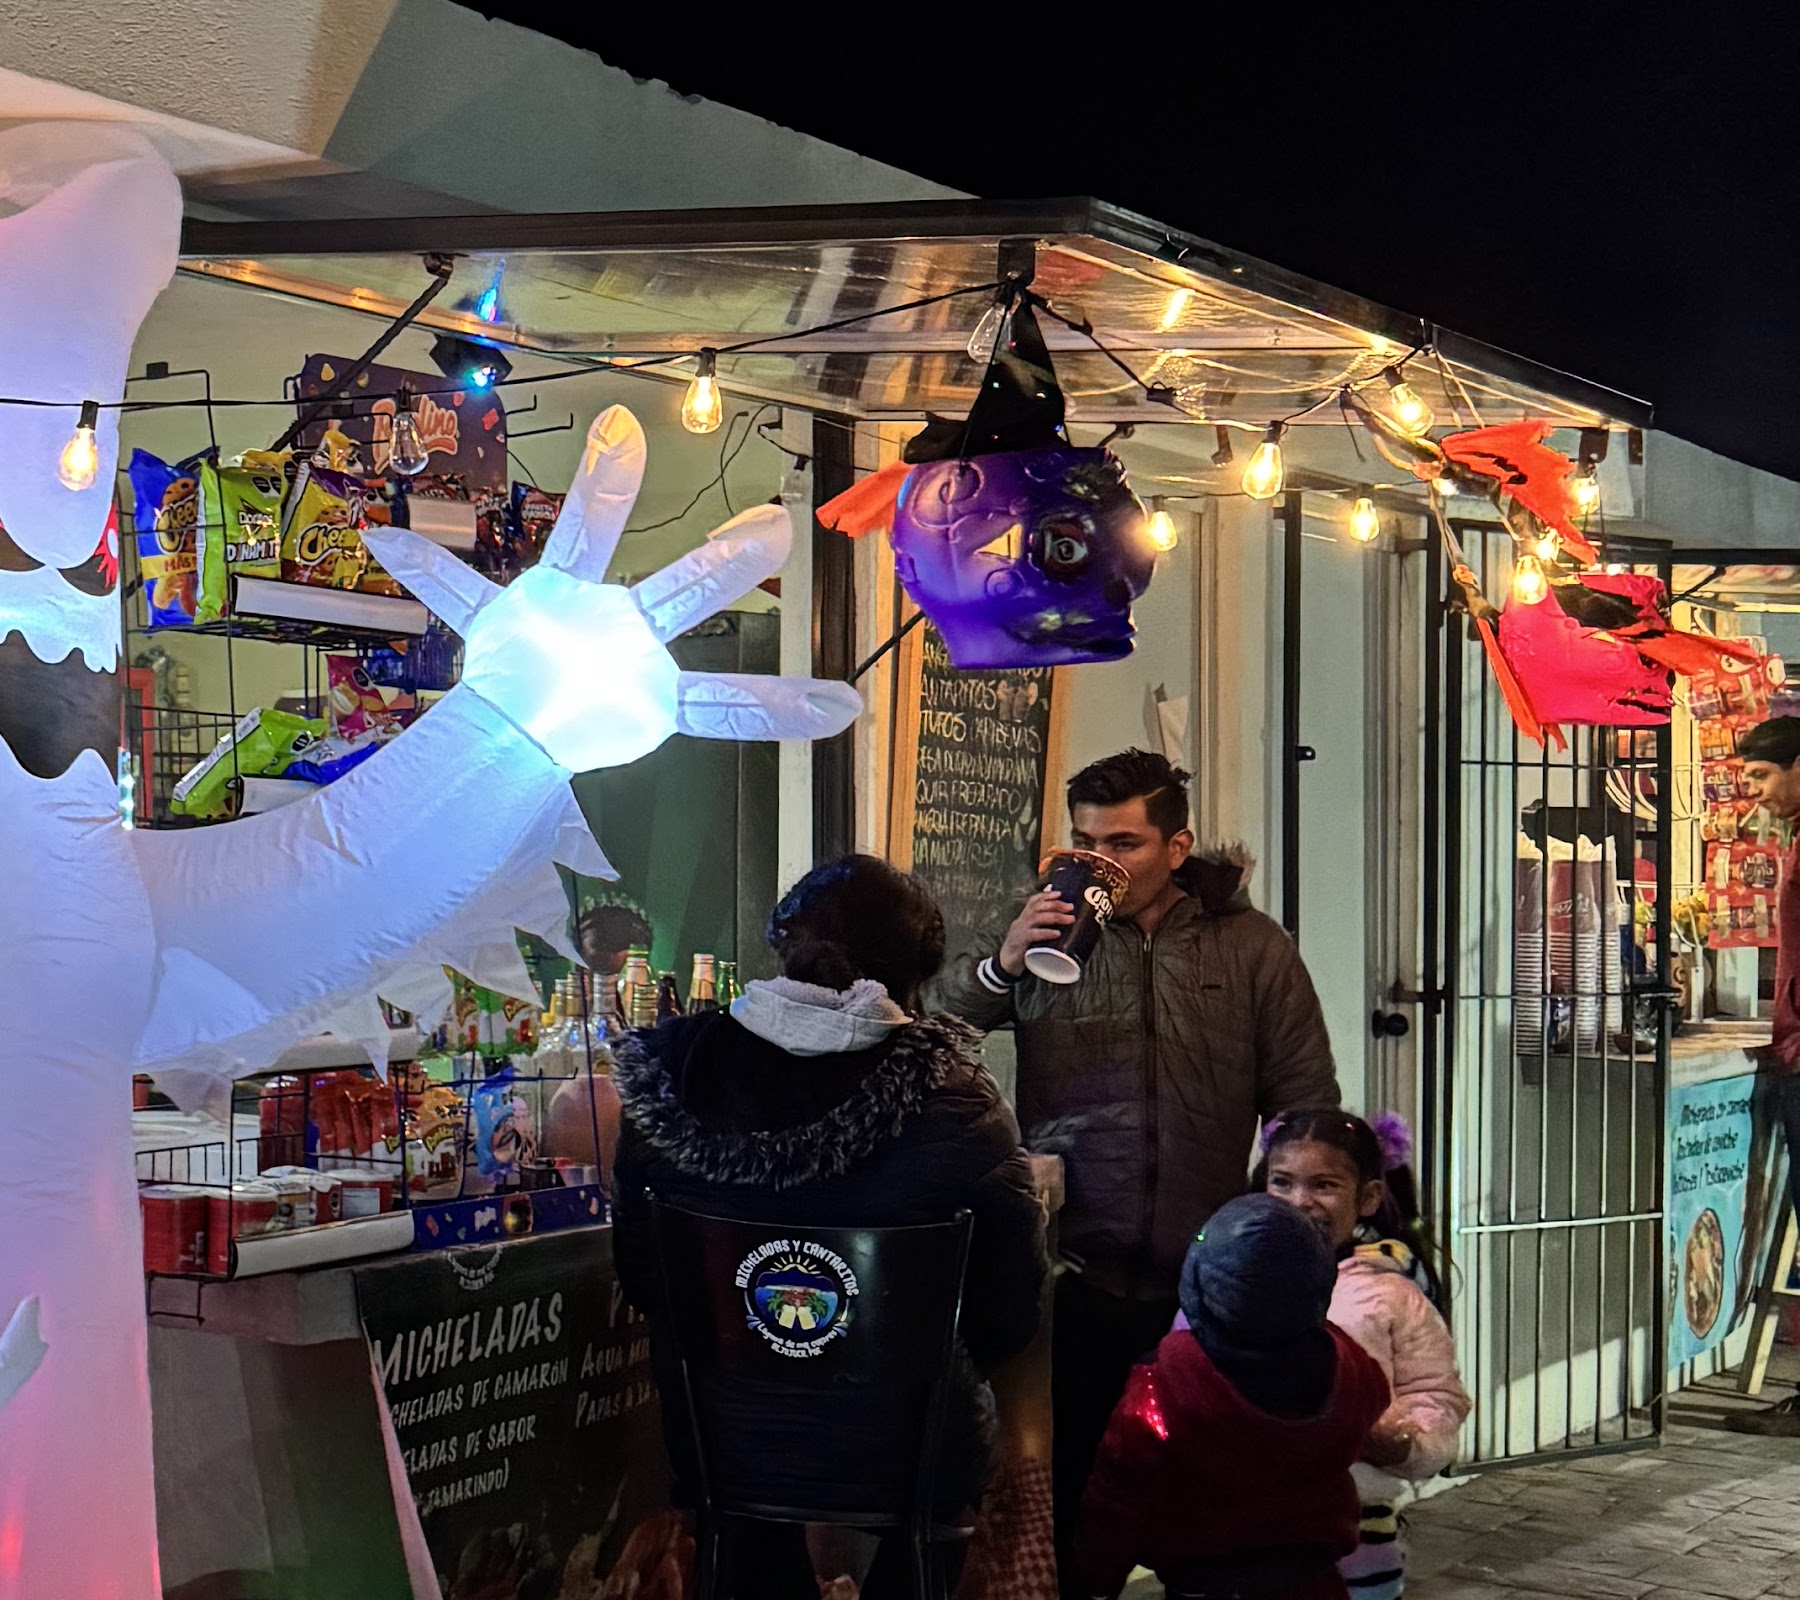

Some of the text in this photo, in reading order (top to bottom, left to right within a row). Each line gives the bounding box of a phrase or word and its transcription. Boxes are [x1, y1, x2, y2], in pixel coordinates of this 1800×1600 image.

[226, 538, 281, 563] DINAMIT
[735, 1239, 860, 1297] MICHELADAS Y CANTARITOS
[374, 1290, 563, 1388] MICHELADAS
[389, 1357, 569, 1431] CHELADAS DE CAMARÓN
[403, 1413, 537, 1476] ELADAS DE SABOR
